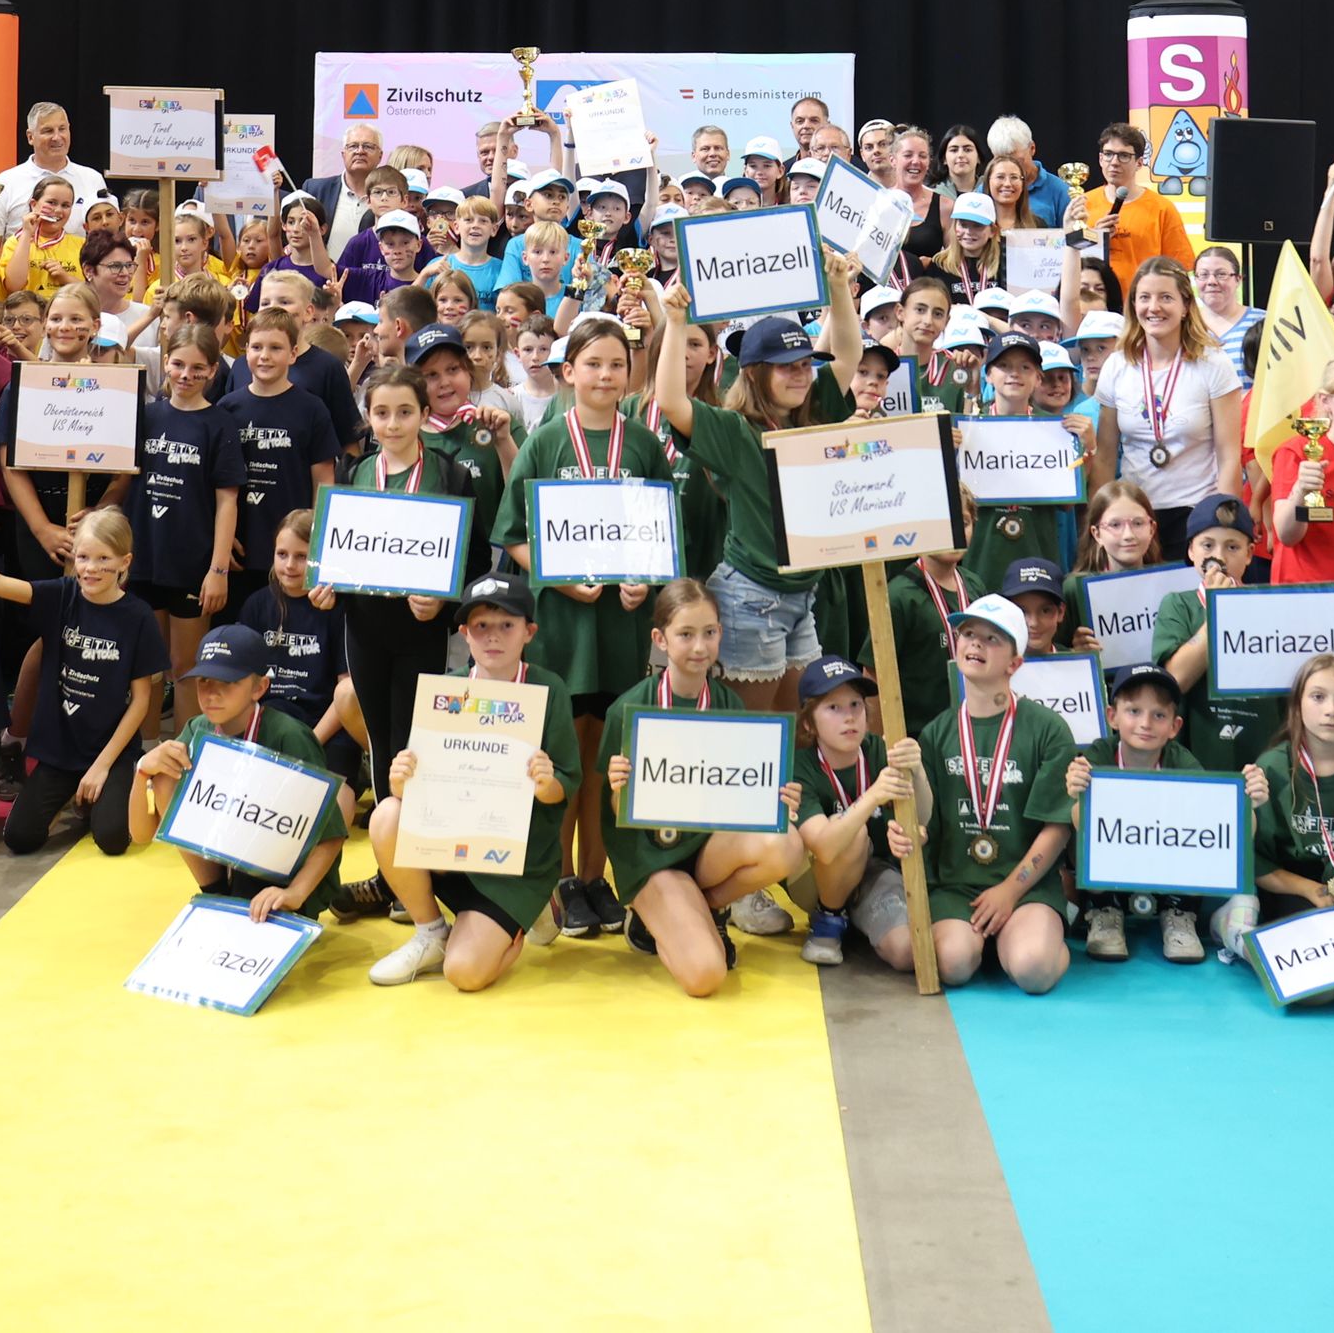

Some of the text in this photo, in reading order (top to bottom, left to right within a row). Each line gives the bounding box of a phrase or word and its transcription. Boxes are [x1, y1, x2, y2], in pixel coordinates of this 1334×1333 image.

[1159, 43, 1206, 102] S
[386, 87, 483, 103] Zivilschutz
[702, 88, 822, 100] Bundesministerium
[386, 104, 436, 116] Österreich
[702, 105, 748, 116] Inneres
[152, 122, 173, 134] Tirol
[120, 134, 205, 150] VS Dorf bei Längenfeld
[695, 245, 810, 282] Mariazell
[43, 403, 105, 418] Oberösterreich
[52, 418, 94, 436] VS Mining
[964, 449, 1069, 470] Mariazell
[831, 474, 896, 497] Steiermark
[829, 491, 907, 518] VS Mariazell
[546, 519, 666, 542] Mariazell
[329, 527, 451, 559] Mariazell
[479, 713, 526, 726] ON TOUR
[443, 738, 510, 755] URKUNDE
[642, 756, 773, 787] Mariazell
[188, 779, 309, 841] Mariazell
[1096, 817, 1231, 851] Mariazell
